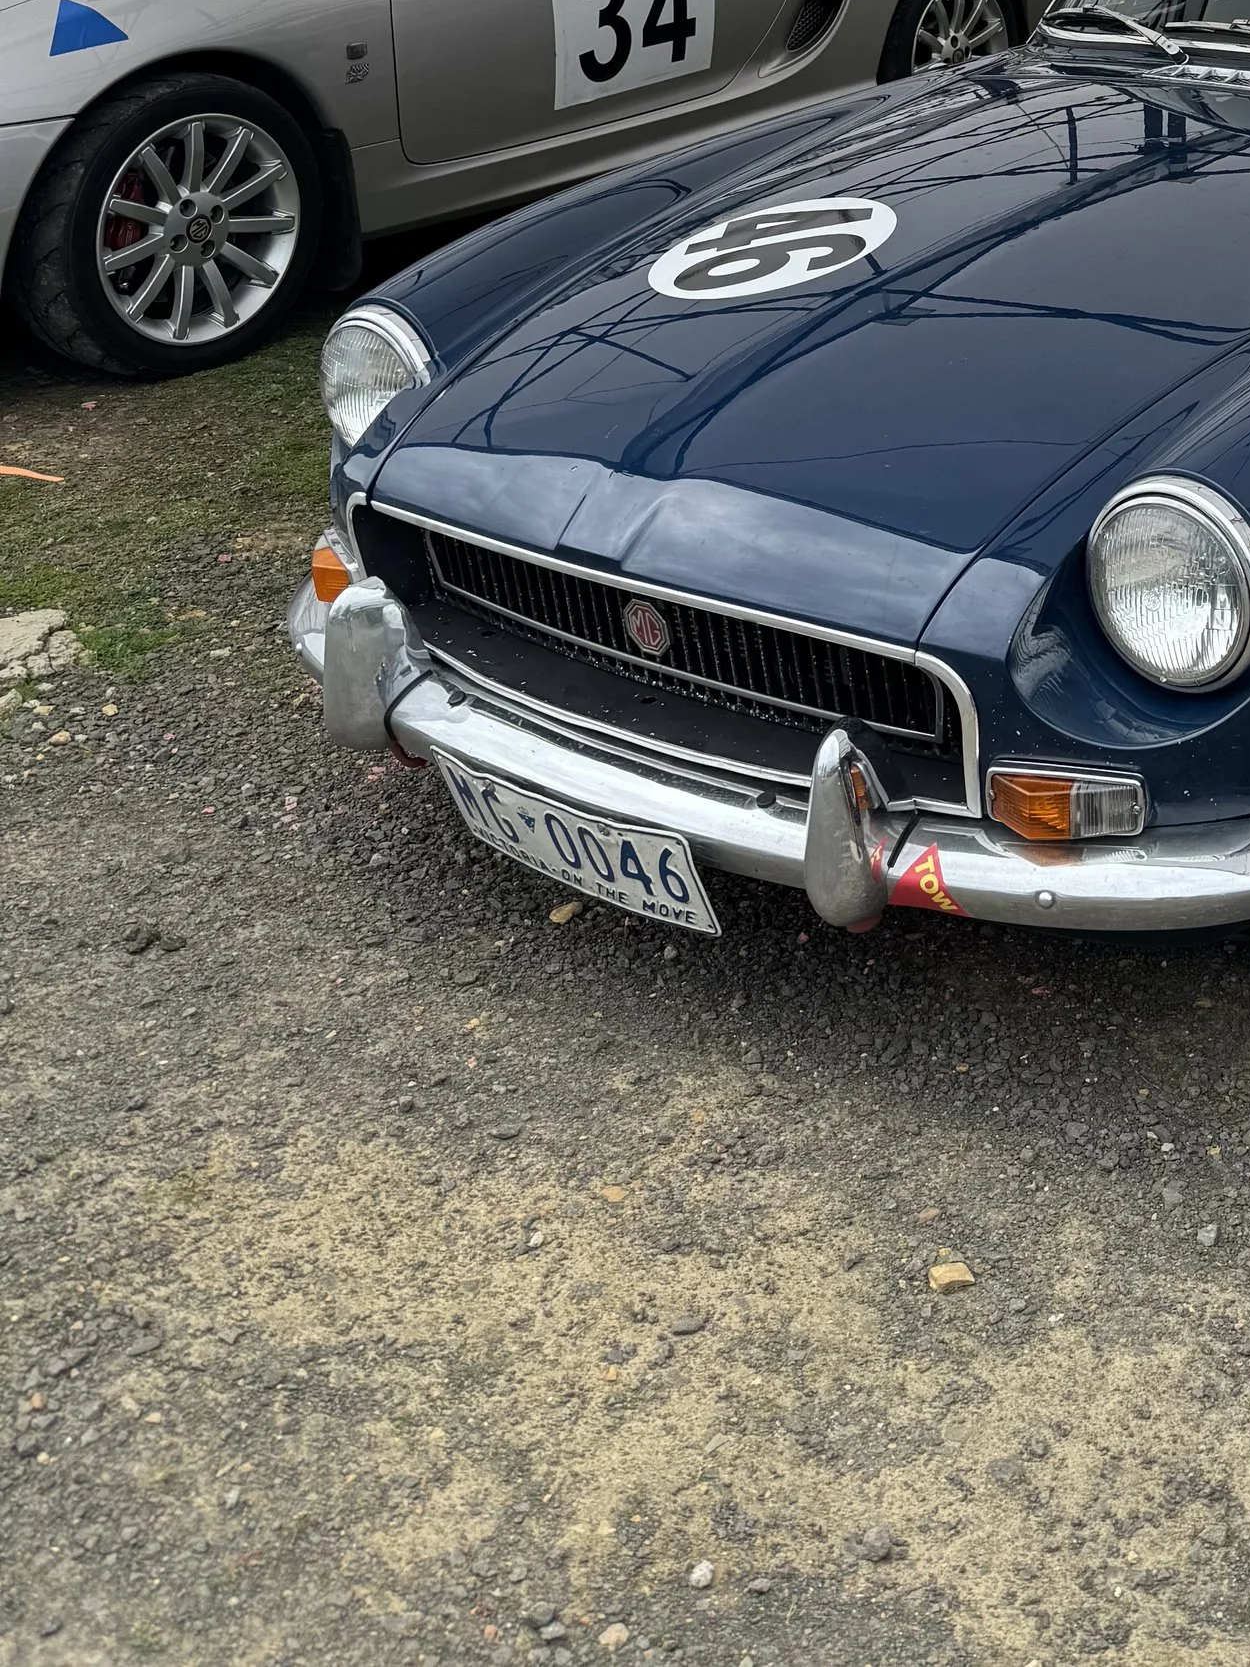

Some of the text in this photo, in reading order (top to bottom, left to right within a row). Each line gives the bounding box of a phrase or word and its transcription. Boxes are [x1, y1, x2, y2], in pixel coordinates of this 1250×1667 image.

[674, 208, 873, 291] 46
[632, 609, 661, 646] MG
[446, 765, 691, 904] MG 0046
[596, 881, 630, 906] THE
[642, 898, 699, 925] MOVE
[915, 855, 959, 911] TOW
